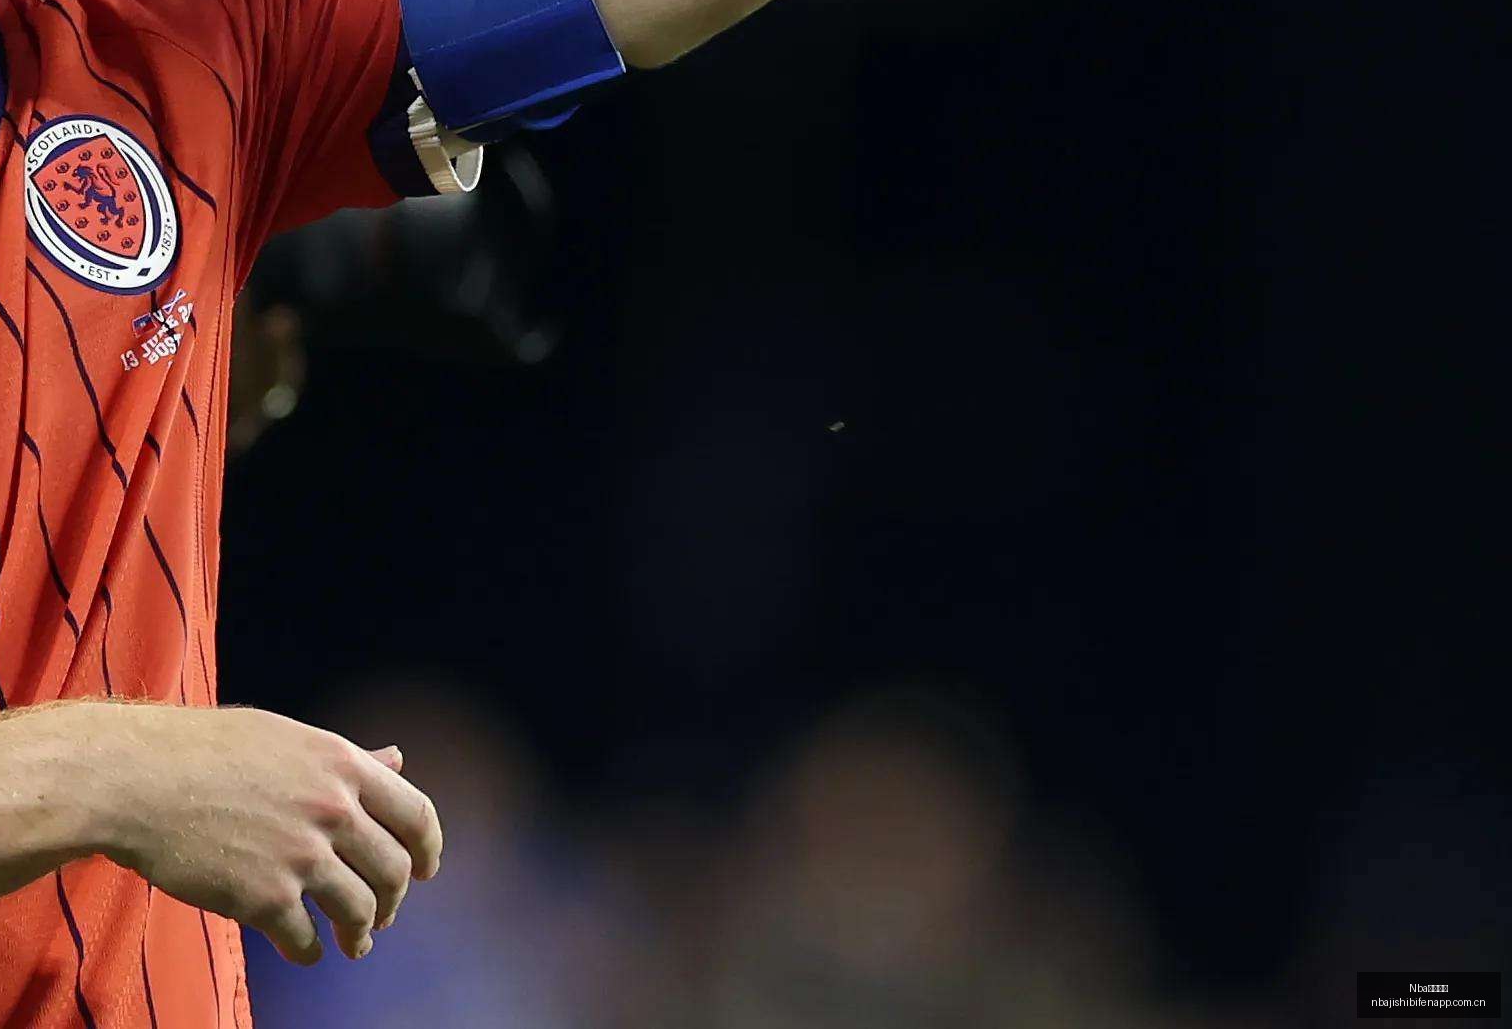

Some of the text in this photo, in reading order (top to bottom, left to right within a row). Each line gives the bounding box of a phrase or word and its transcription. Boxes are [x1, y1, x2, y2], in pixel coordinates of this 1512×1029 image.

[27, 123, 93, 166] SCOTLAND
[161, 224, 174, 252] 1873
[88, 265, 111, 282] EST
